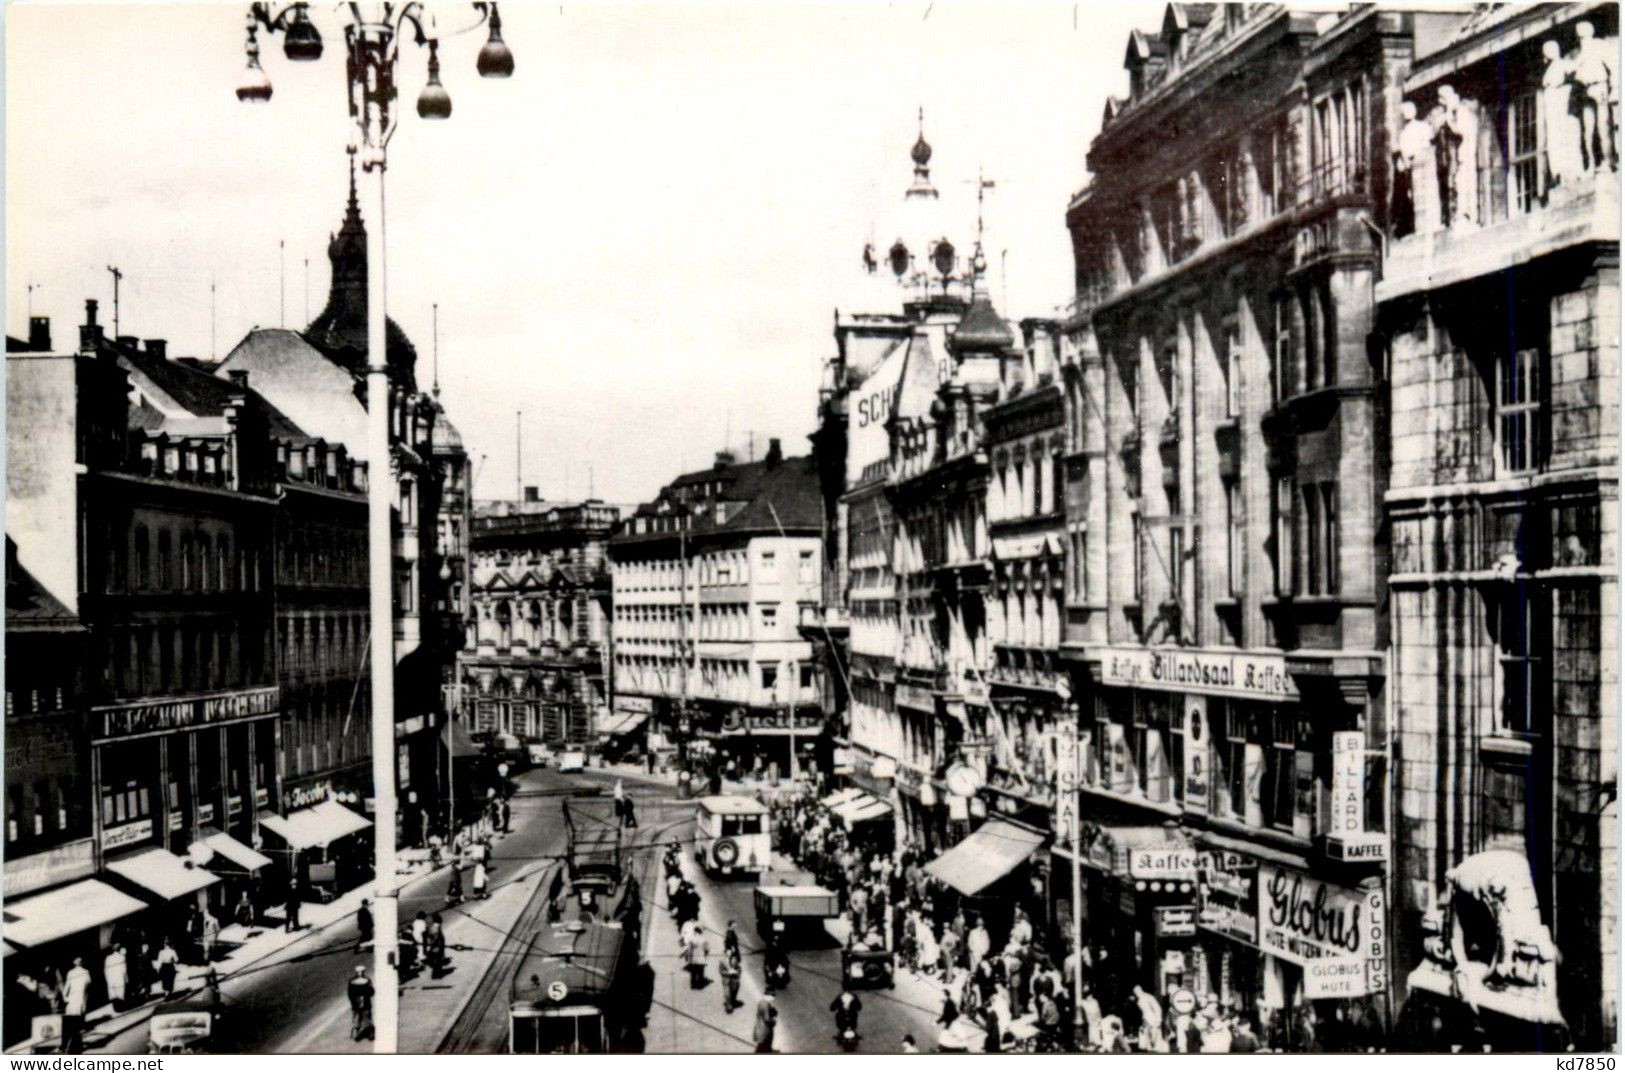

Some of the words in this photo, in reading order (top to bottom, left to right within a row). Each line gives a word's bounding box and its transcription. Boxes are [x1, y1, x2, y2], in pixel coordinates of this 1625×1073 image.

[1346, 738, 1358, 831] BILLARD
[1347, 844, 1383, 857] KAFFEE
[1267, 867, 1360, 953] Globus
[1370, 895, 1382, 988] GLOBUS
[551, 984, 563, 998] 5
[1312, 963, 1361, 977] GLOBUS
